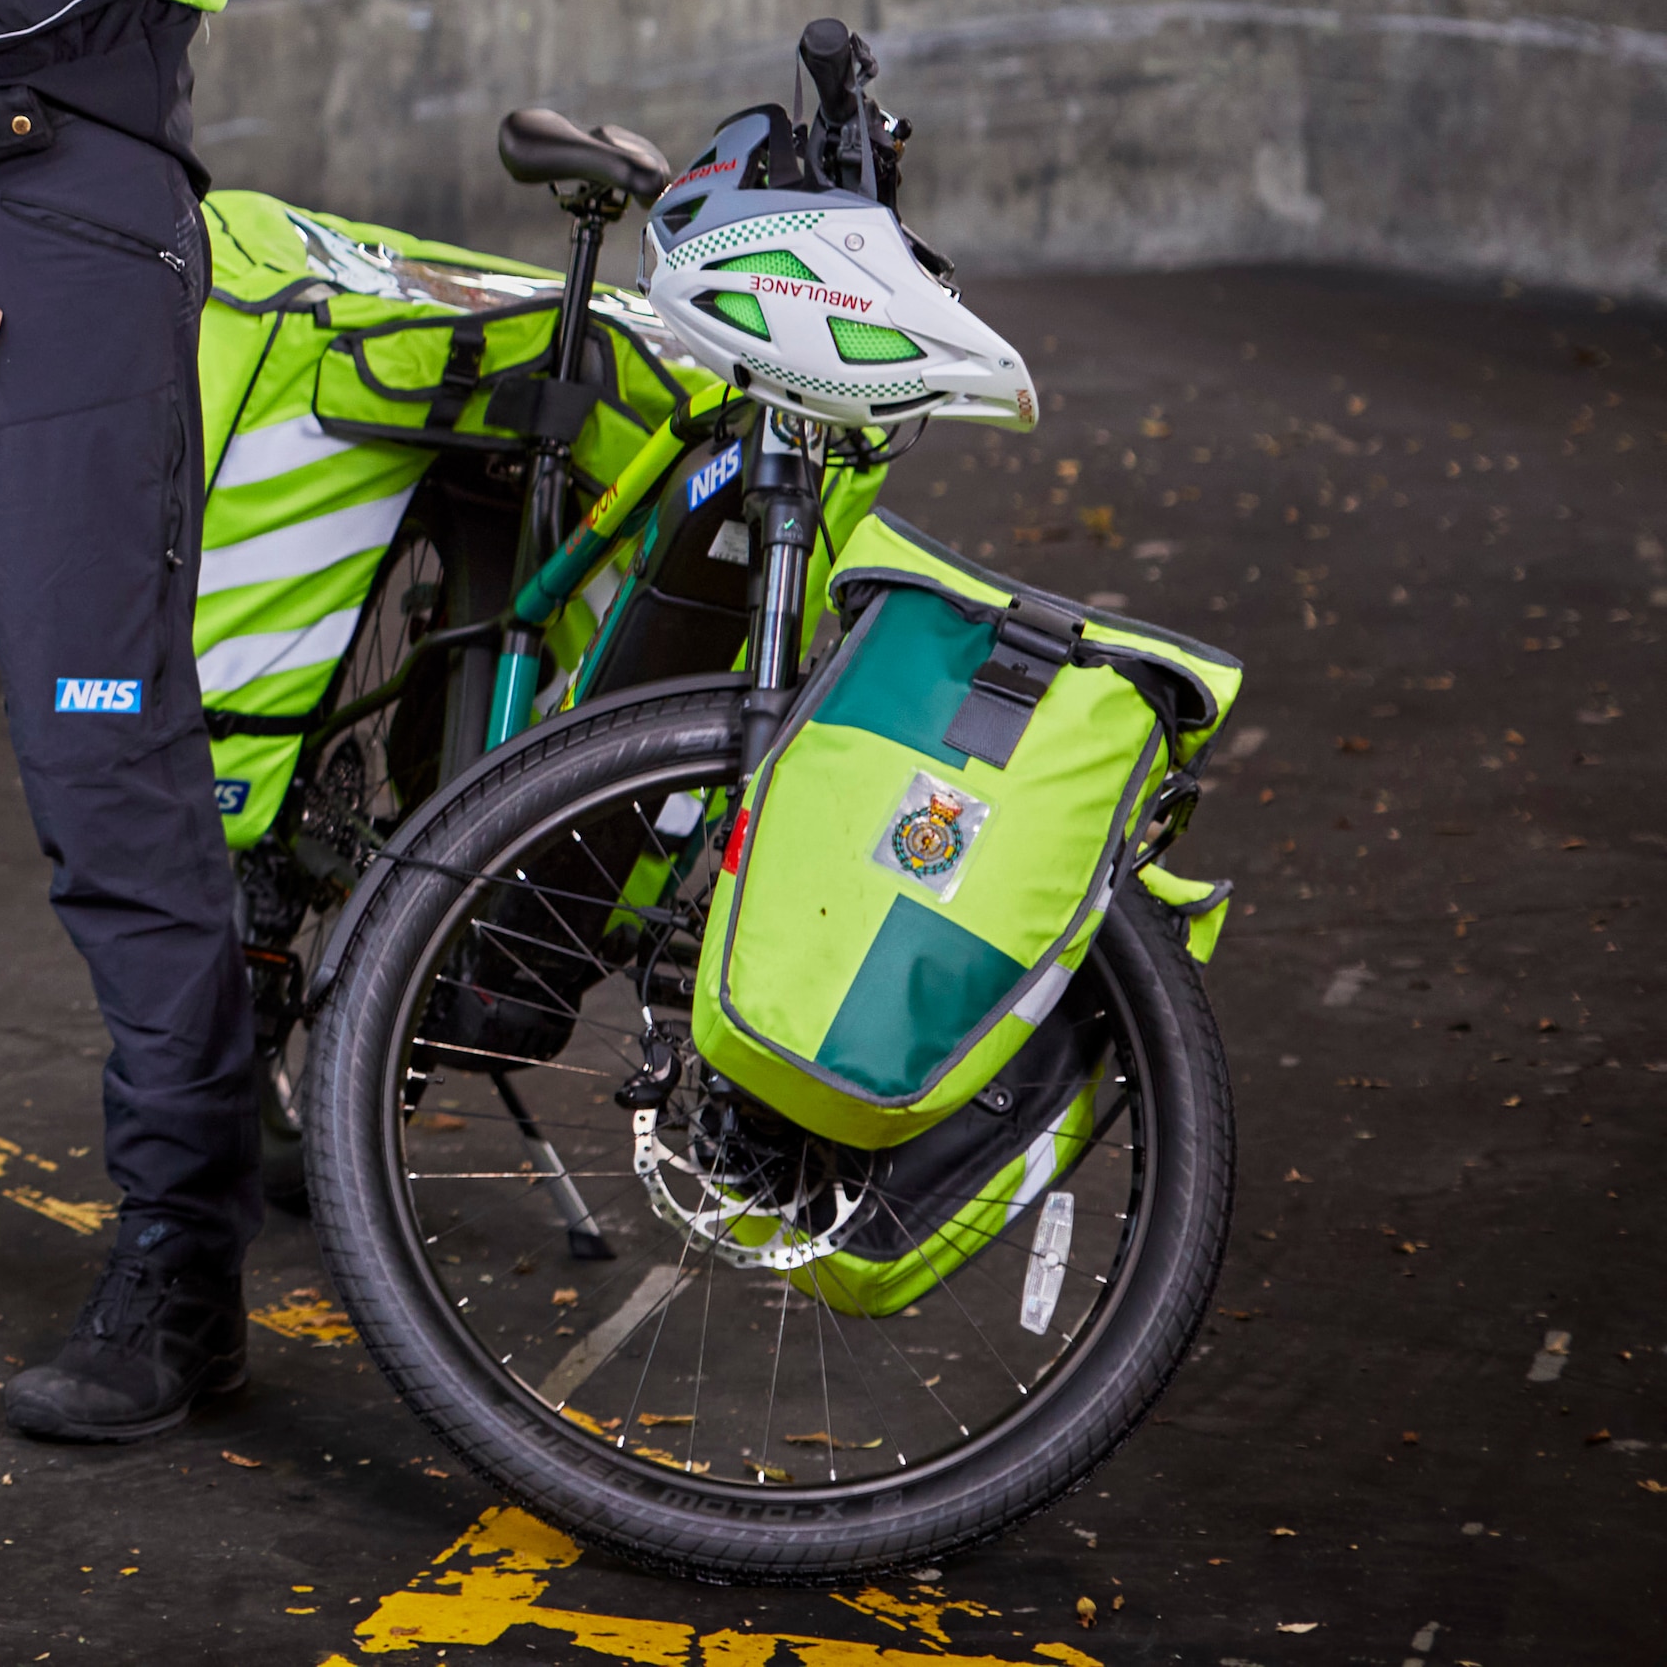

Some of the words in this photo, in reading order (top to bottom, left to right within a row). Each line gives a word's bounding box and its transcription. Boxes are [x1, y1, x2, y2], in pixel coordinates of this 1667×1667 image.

[749, 275, 873, 313] AMBULANCE
[690, 443, 740, 508] NHS
[60, 680, 138, 710] NHS
[495, 1401, 647, 1493] SUPER
[657, 1489, 845, 1523] MOTO-X
